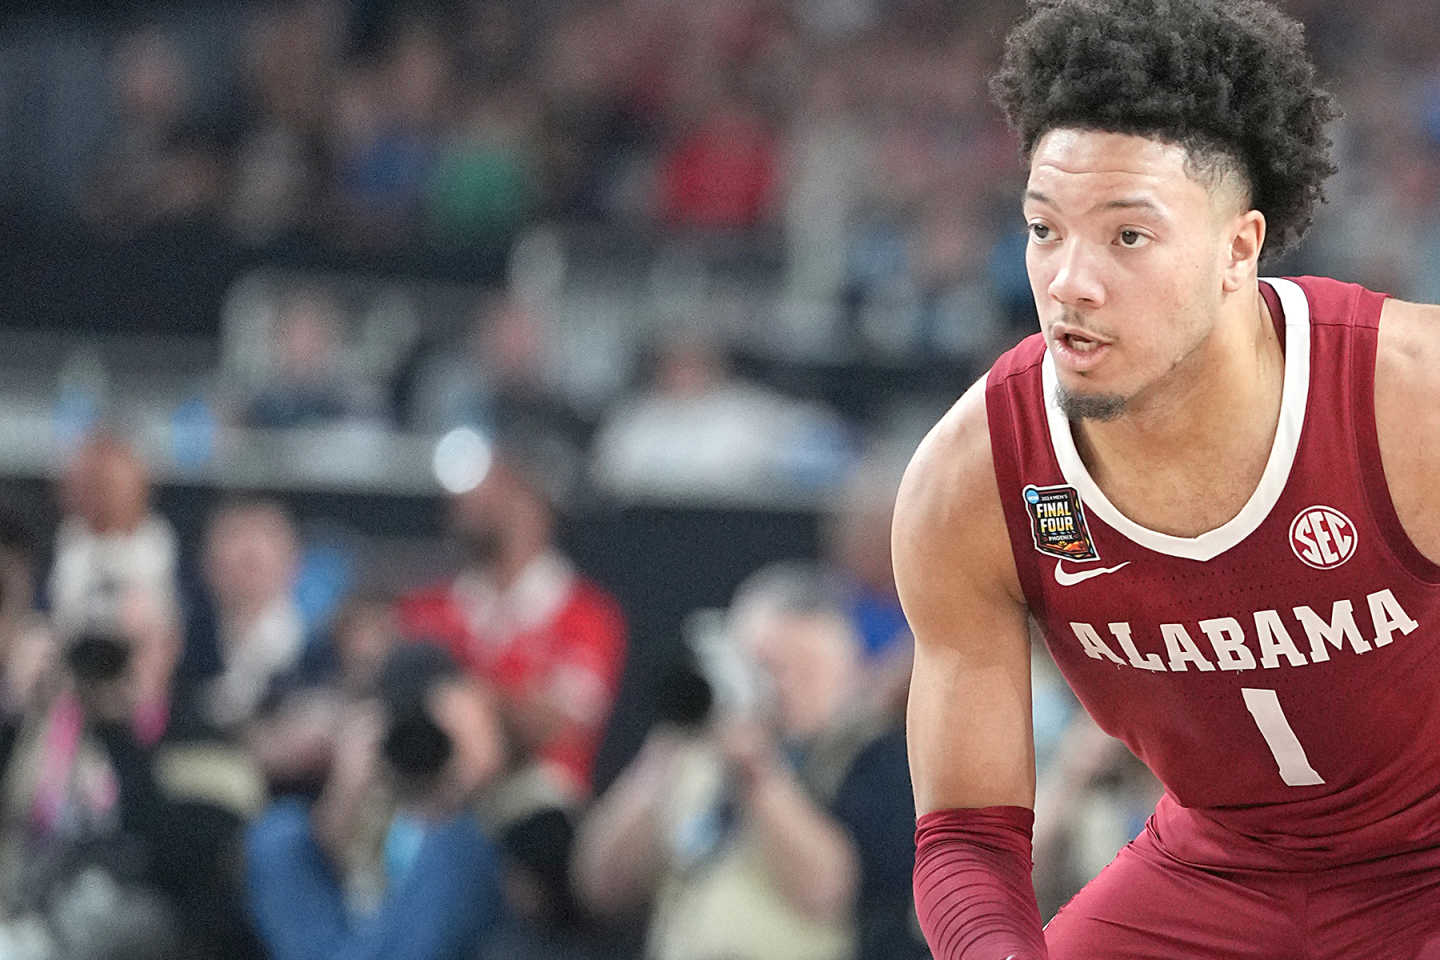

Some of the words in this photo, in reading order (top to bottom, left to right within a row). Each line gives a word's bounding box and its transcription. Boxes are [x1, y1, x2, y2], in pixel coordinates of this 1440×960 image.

[1036, 501, 1071, 518] FINAL
[1040, 516, 1074, 533] FOUR
[1294, 509, 1354, 565] SEC
[1069, 588, 1419, 672] ALABAMA
[1241, 687, 1326, 787] 1
